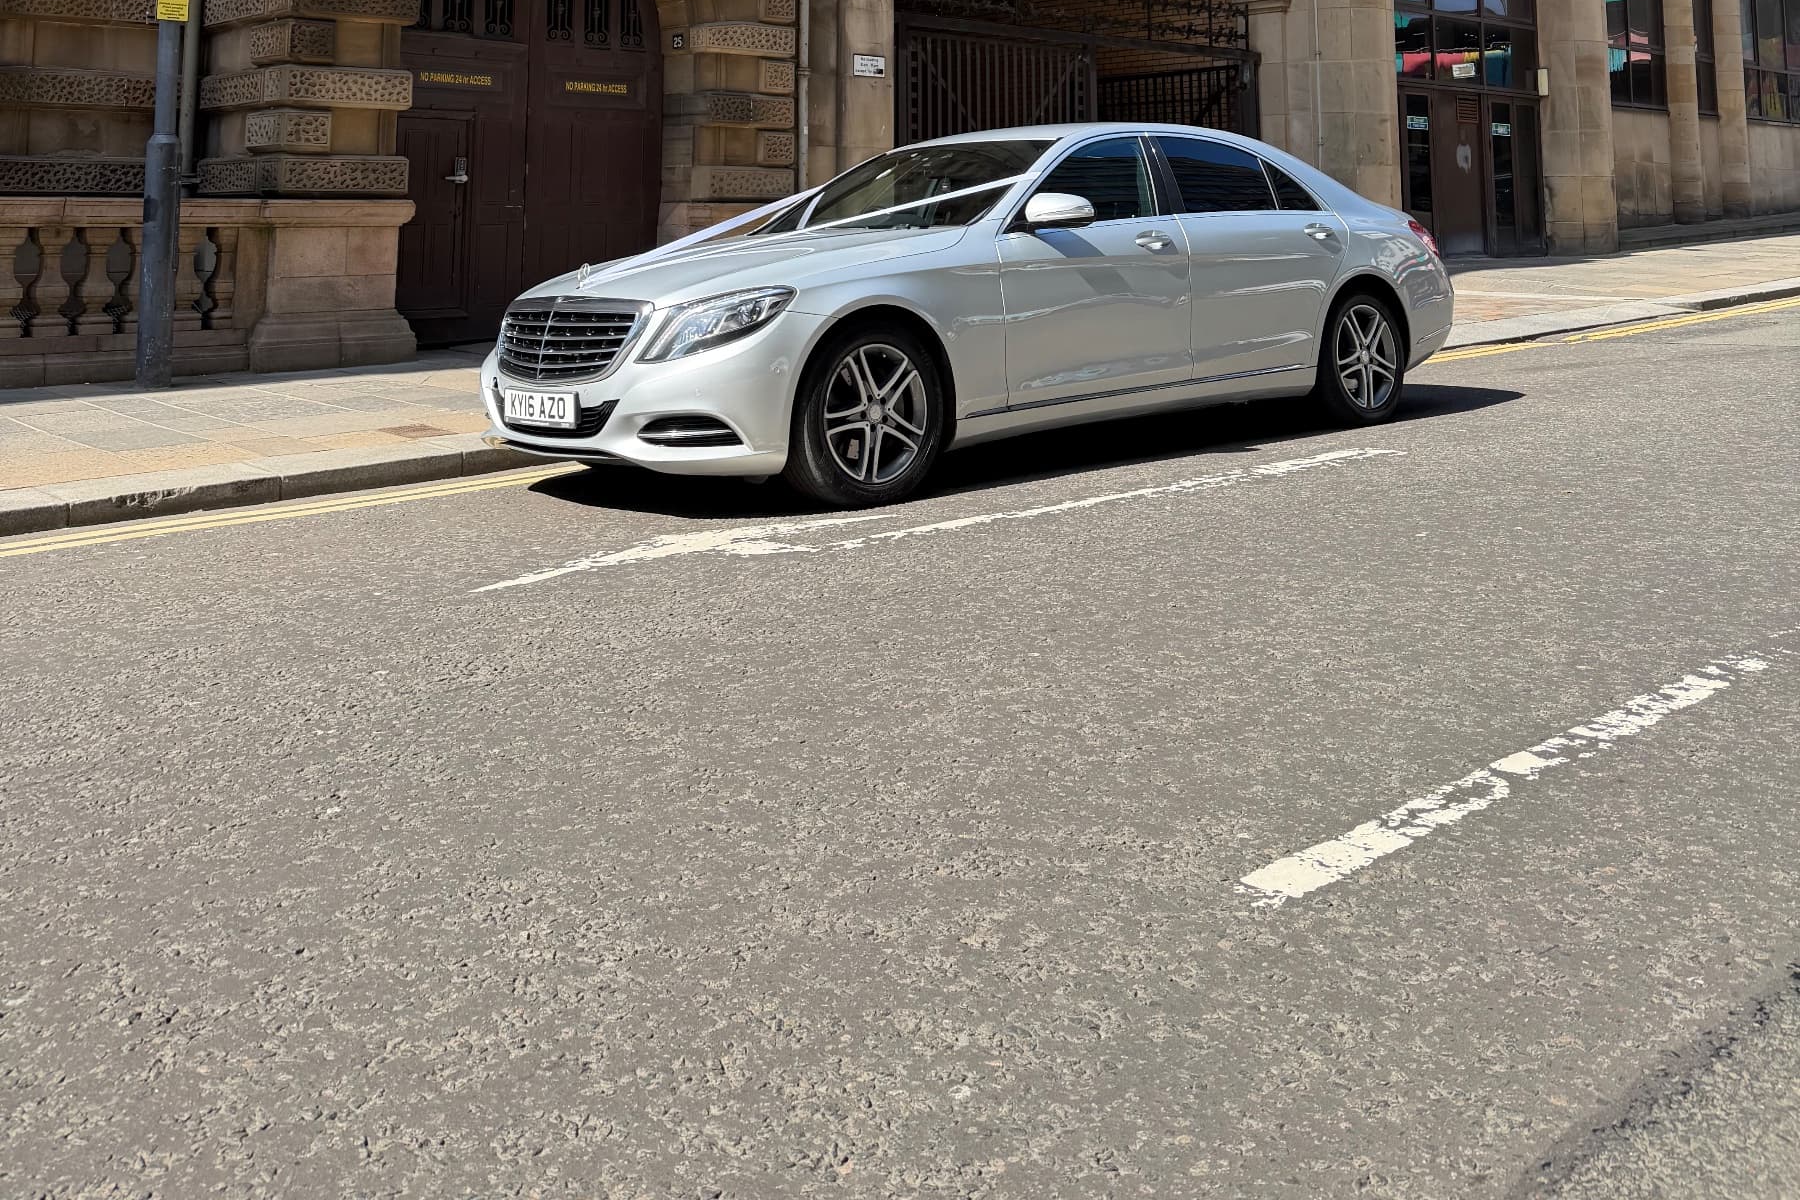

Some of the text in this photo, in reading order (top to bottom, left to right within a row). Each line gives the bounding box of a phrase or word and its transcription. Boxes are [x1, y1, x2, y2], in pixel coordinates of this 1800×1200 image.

[673, 36, 682, 48] 25
[420, 71, 429, 82] NO
[429, 72, 455, 84] PARKING
[455, 74, 462, 84] 24
[469, 75, 492, 86] ACCESS
[565, 80, 574, 91] NO
[574, 81, 596, 92] PARKING
[607, 84, 628, 94] ACCESS
[511, 393, 565, 419] KY16 AZO
